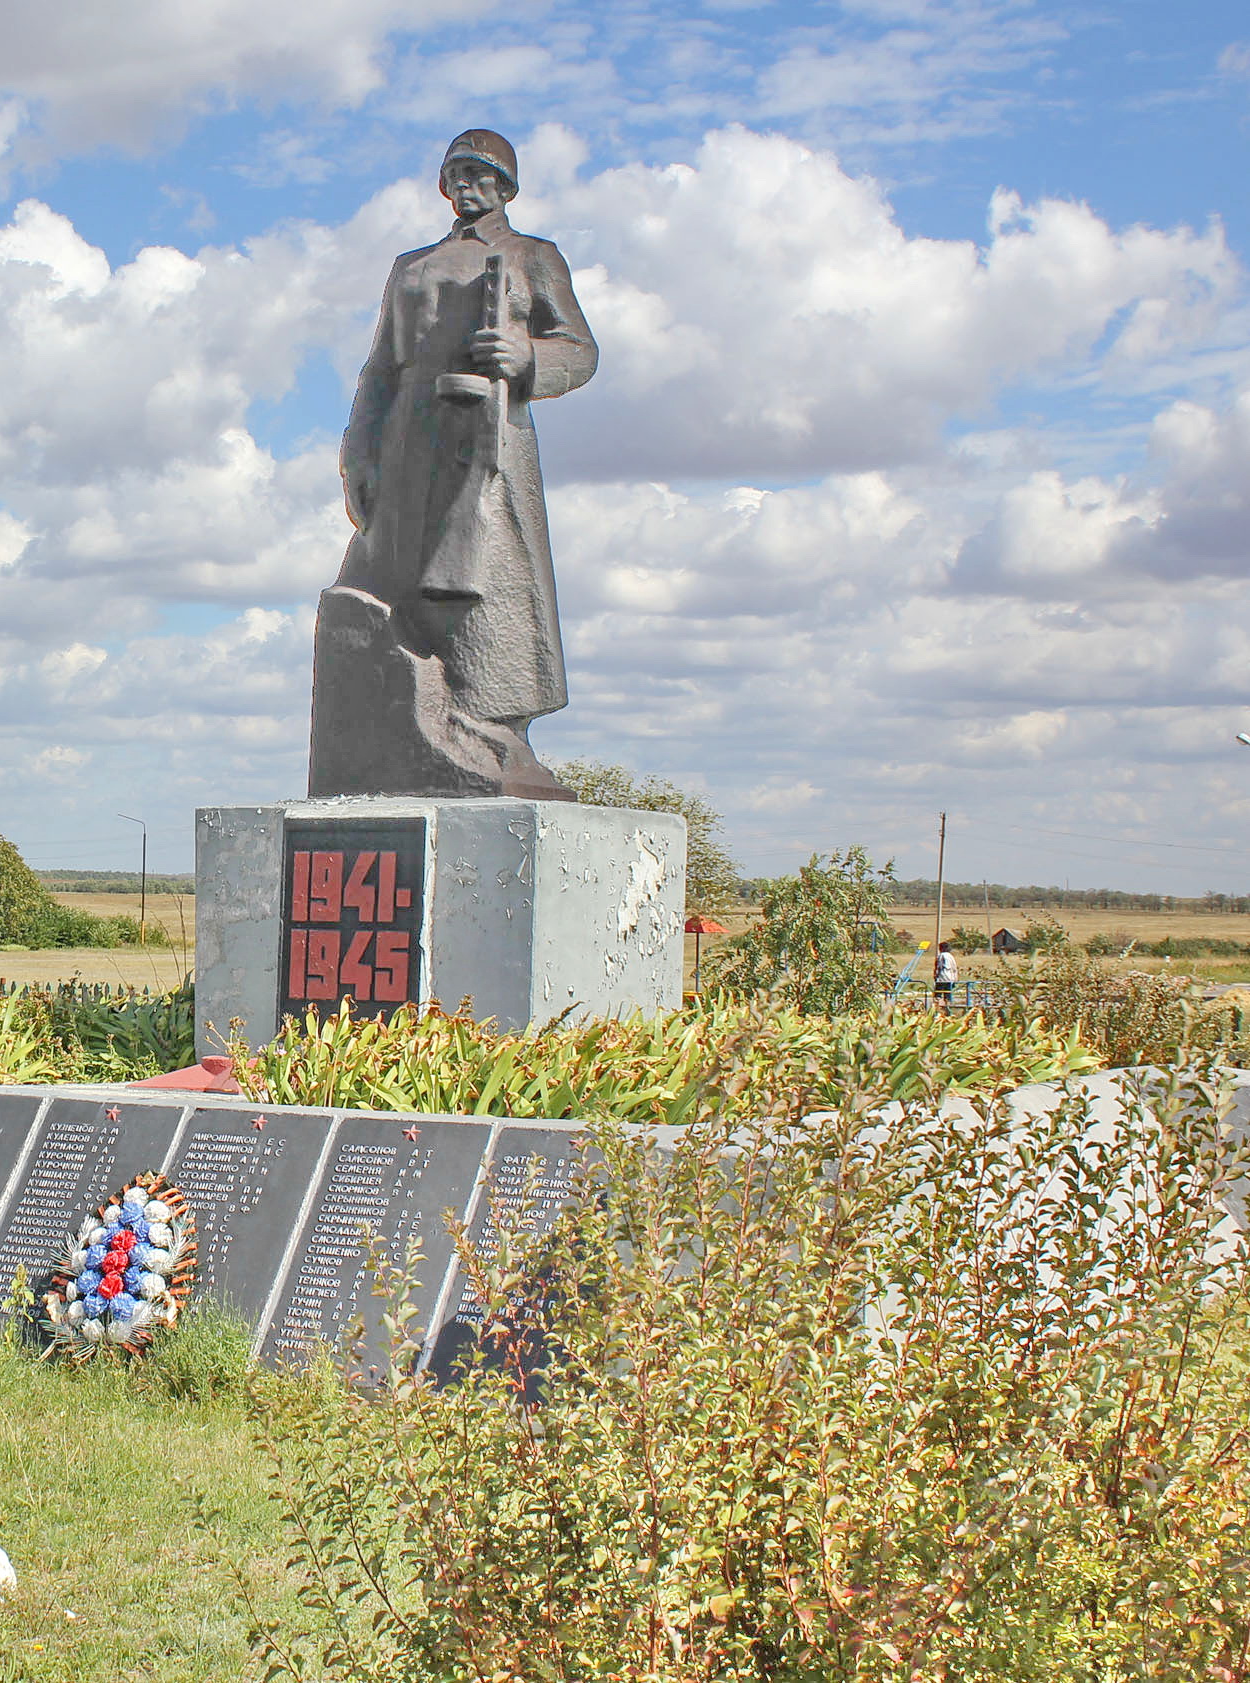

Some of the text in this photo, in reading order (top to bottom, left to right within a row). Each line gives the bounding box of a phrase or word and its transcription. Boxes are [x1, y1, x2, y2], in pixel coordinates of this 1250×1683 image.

[288, 929, 410, 1002] 1945
[342, 1144, 397, 1155] САМСОНОВ
[338, 1154, 394, 1165] САМСОНОВ
[182, 1162, 239, 1172] ОВЧАРЕНКО
[174, 1181, 234, 1192] ОСТАШЕНКО
[325, 1194, 389, 1206] СКРЫННИКОВ
[321, 1204, 386, 1216] СКРЫННИКОВ
[315, 1225, 377, 1237] СМОЛДЫРВ
[308, 1245, 361, 1257] СТАШЕНКО
[304, 1255, 342, 1266] СУЧКОВ
